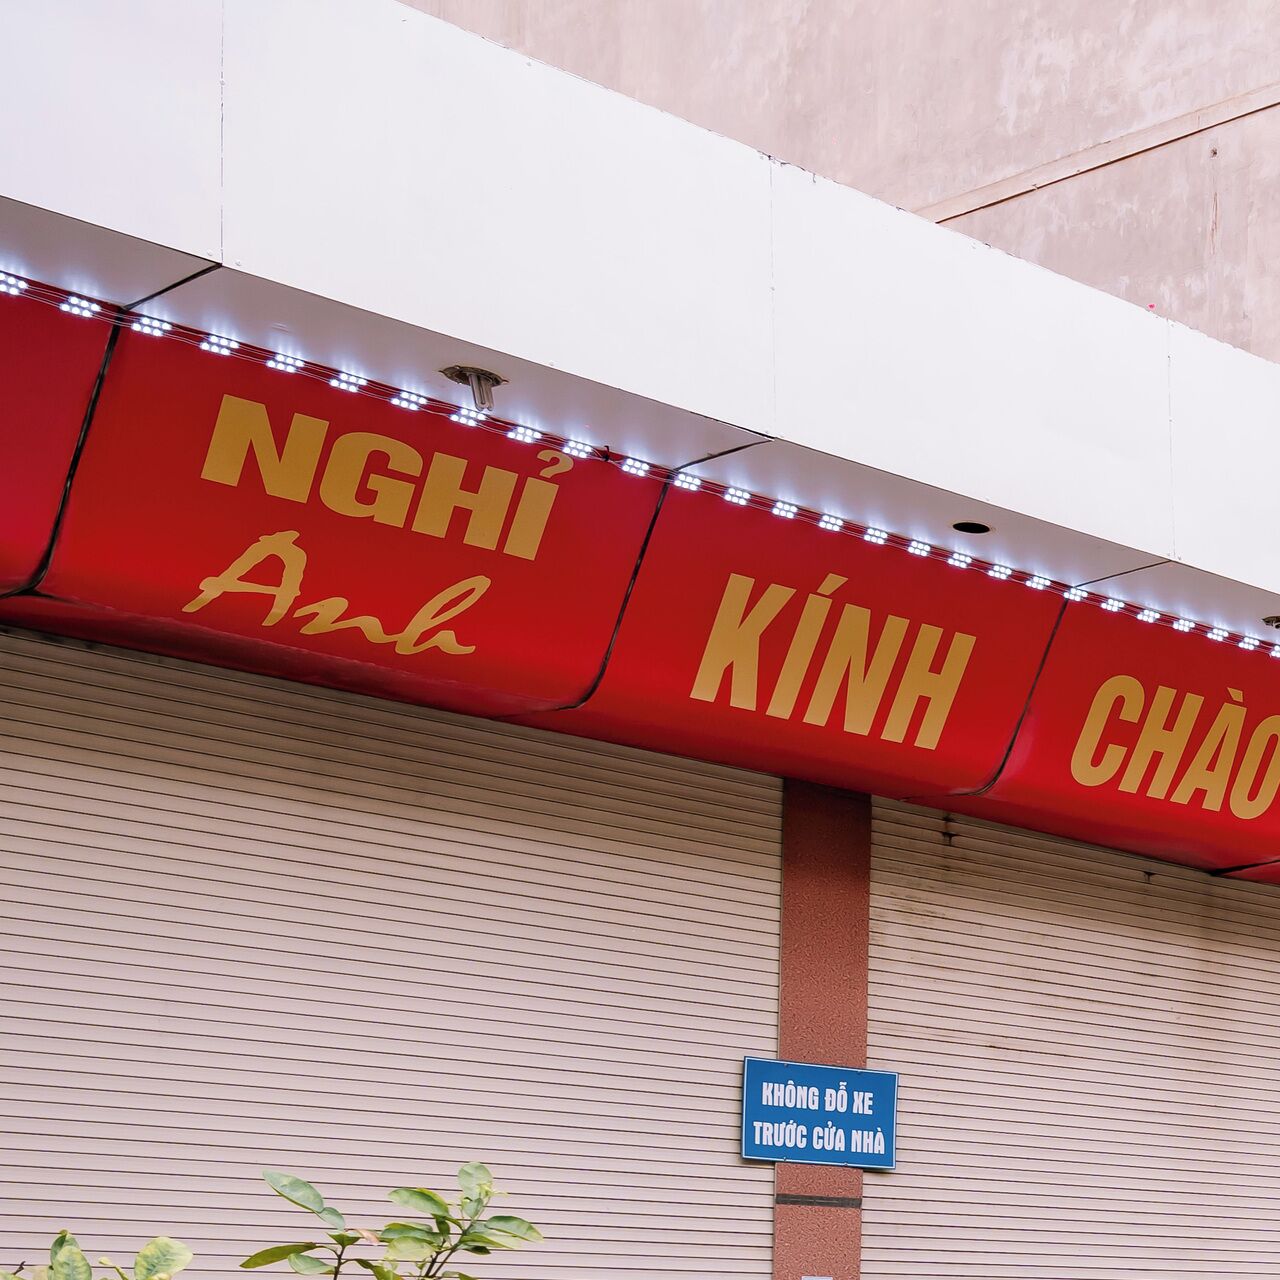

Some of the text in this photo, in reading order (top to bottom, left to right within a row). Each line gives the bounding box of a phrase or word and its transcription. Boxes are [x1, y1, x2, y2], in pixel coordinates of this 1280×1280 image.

[200, 394, 573, 560] NGHỈ
[183, 530, 491, 655] Anh
[690, 573, 977, 750] KÍNH
[753, 1119, 885, 1154] TRƯỚC CỬA NHÀ
[762, 1080, 874, 1115] KHÔNG ĐỖ XE
